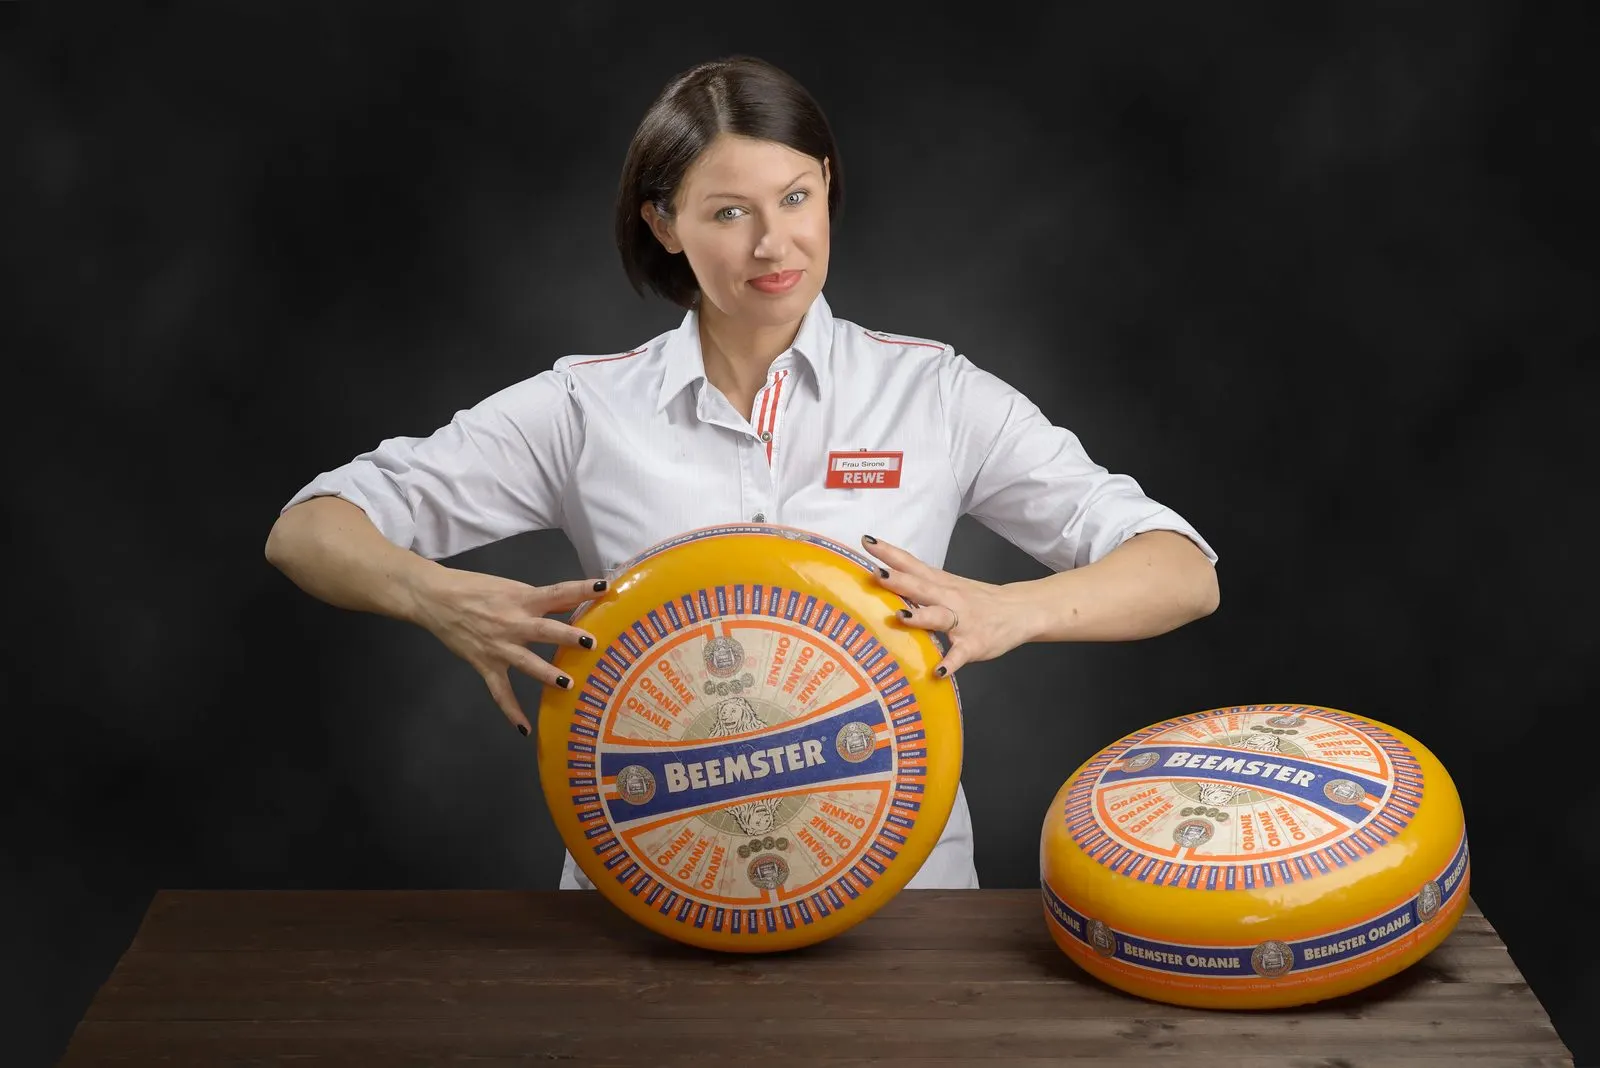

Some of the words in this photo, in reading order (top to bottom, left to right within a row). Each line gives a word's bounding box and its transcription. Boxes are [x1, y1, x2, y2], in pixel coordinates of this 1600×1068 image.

[843, 472, 885, 483] REWE
[766, 637, 791, 686] ORANJE
[782, 646, 814, 694] ORANJE
[640, 677, 682, 717] ORANJE
[658, 660, 695, 705] ORANJE
[797, 660, 836, 704] ORANJE
[626, 696, 672, 731] ORANJE
[664, 739, 826, 794] BEEMSTER
[1163, 752, 1316, 787] BEEMSTER
[820, 800, 865, 829] ORANJE
[1110, 788, 1158, 811] ORANJE
[1117, 795, 1165, 823] ORANJE
[810, 816, 851, 849] ORANJE
[1130, 802, 1174, 834] ORANJE
[1240, 814, 1255, 850] ORANJE
[1258, 811, 1281, 847] ORANJE
[1275, 806, 1306, 840] ORANJE
[657, 828, 695, 866] ORANJE
[678, 837, 709, 879] ORANJE
[797, 827, 833, 867] ORANJE
[701, 846, 725, 889] ORANJE
[1054, 902, 1080, 932] ORANJE
[1304, 934, 1366, 961] BEEMSTER
[1368, 912, 1411, 941] ORANJE
[1124, 942, 1183, 966] BEEMSTER
[1185, 954, 1240, 969] ORANJE
